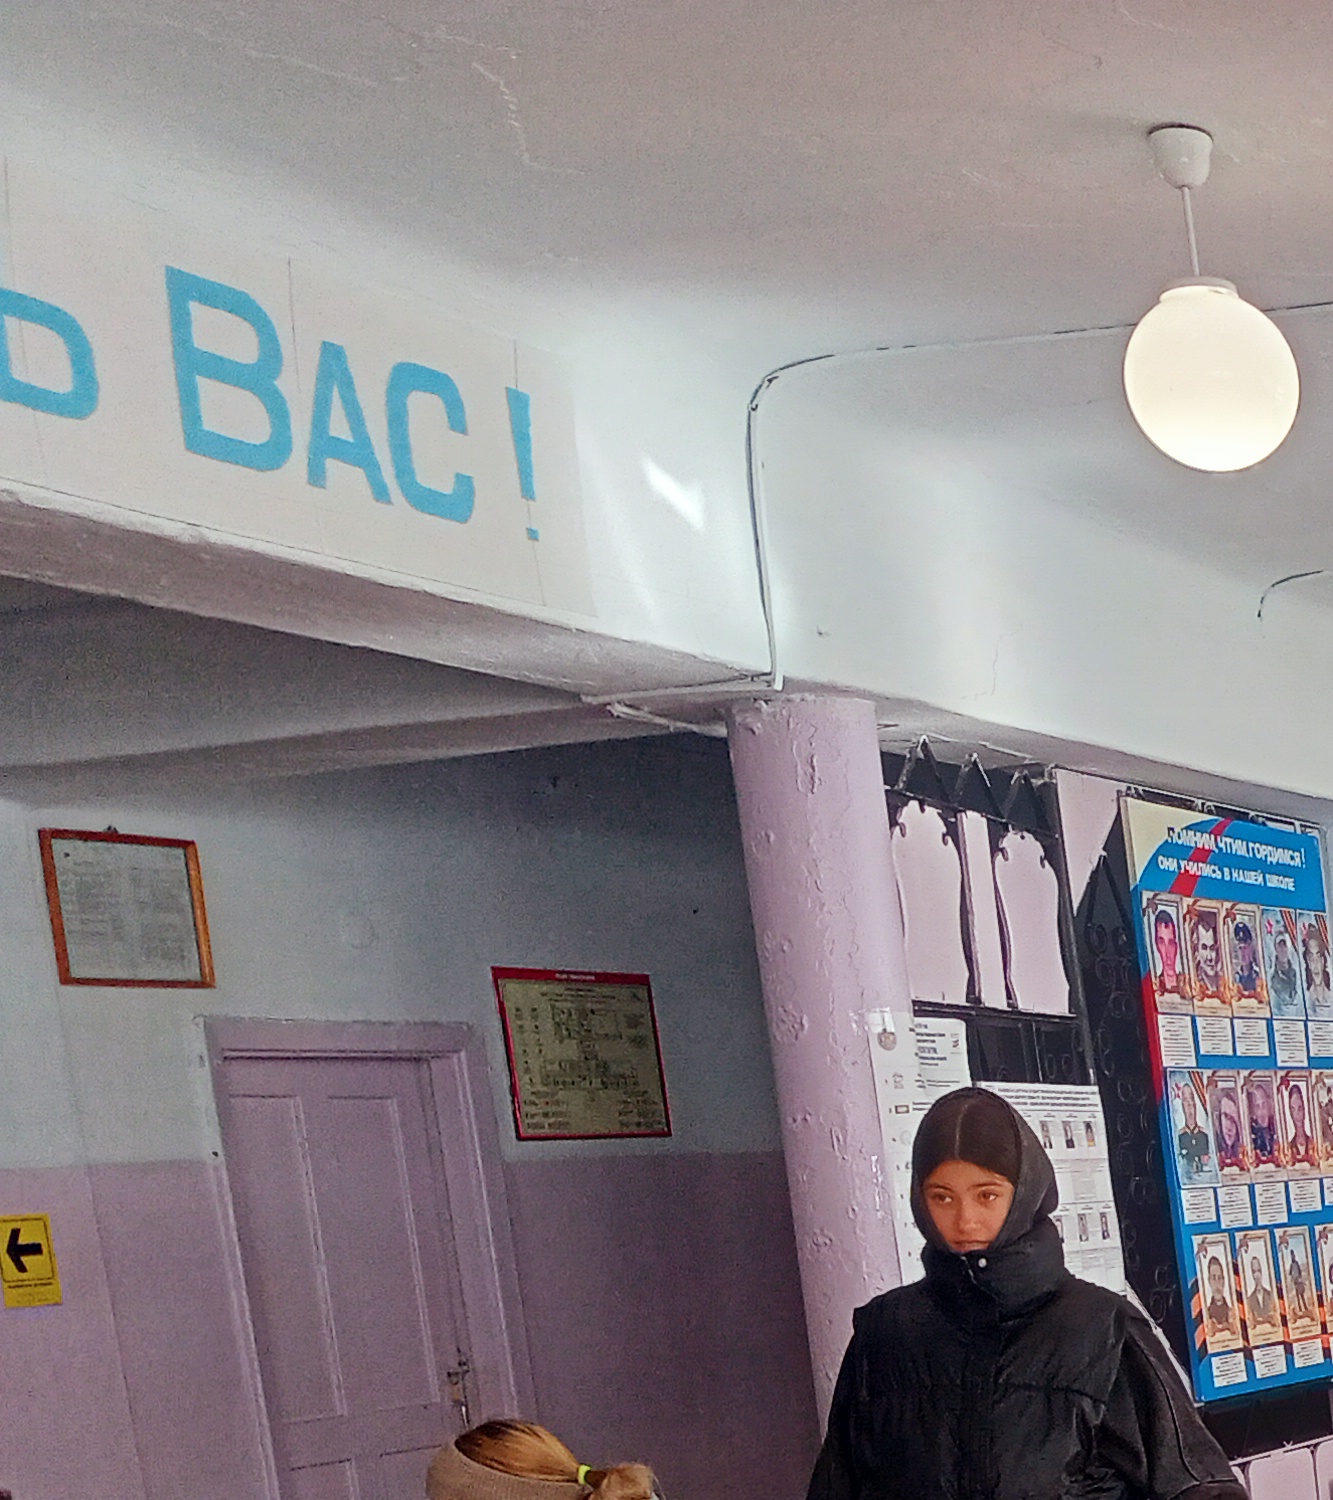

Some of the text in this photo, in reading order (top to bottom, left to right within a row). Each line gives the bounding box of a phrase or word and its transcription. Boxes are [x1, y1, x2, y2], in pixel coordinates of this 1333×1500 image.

[1157, 855, 1296, 891] ОНИ УЧИЛИСЬ В НАШЕЙ ШКОЛЕ
